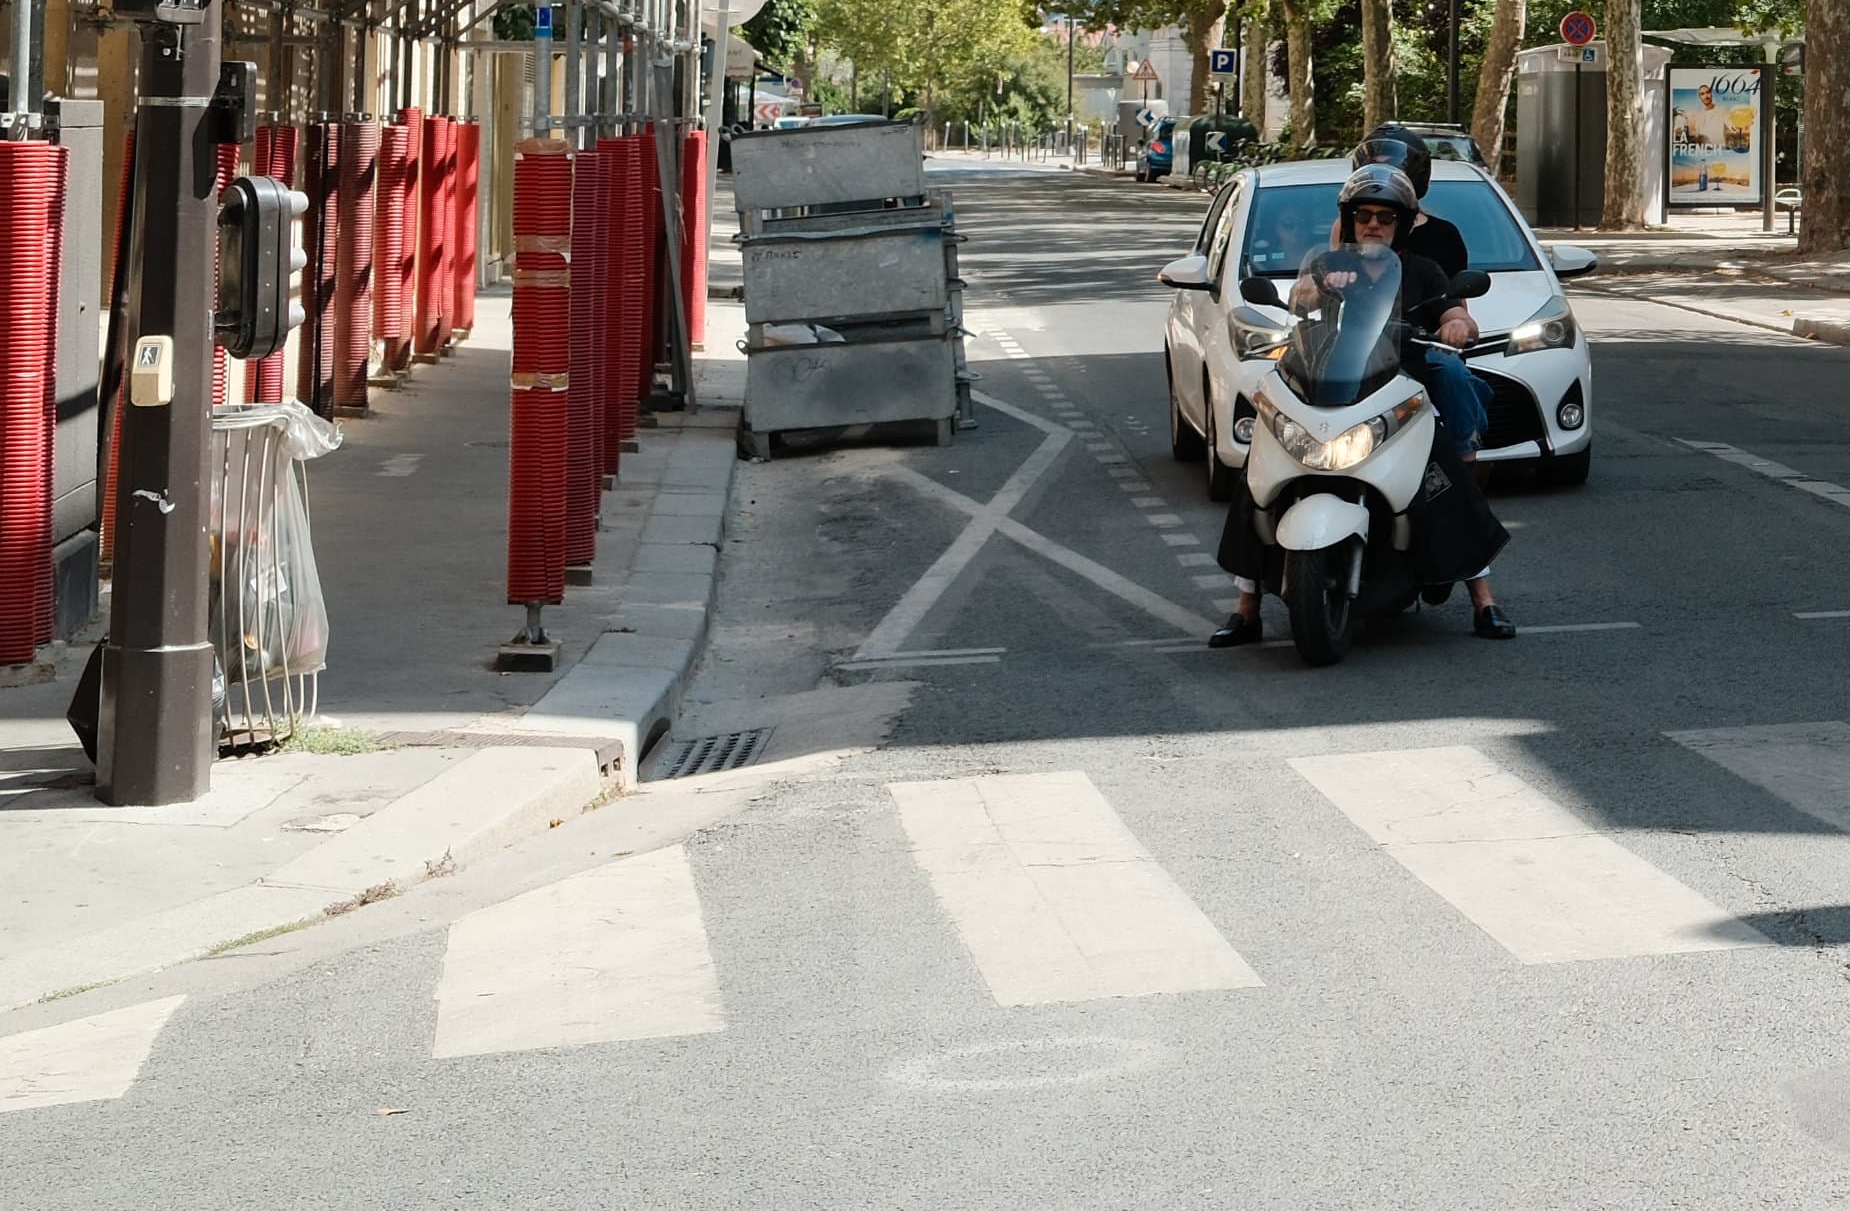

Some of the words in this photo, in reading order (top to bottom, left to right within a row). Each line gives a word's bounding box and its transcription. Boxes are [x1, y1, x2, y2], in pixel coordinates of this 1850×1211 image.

[1217, 54, 1229, 70] P
[1710, 74, 1760, 95] 1664
[1673, 131, 1688, 143] LA
[1672, 143, 1722, 157] FRENCH
